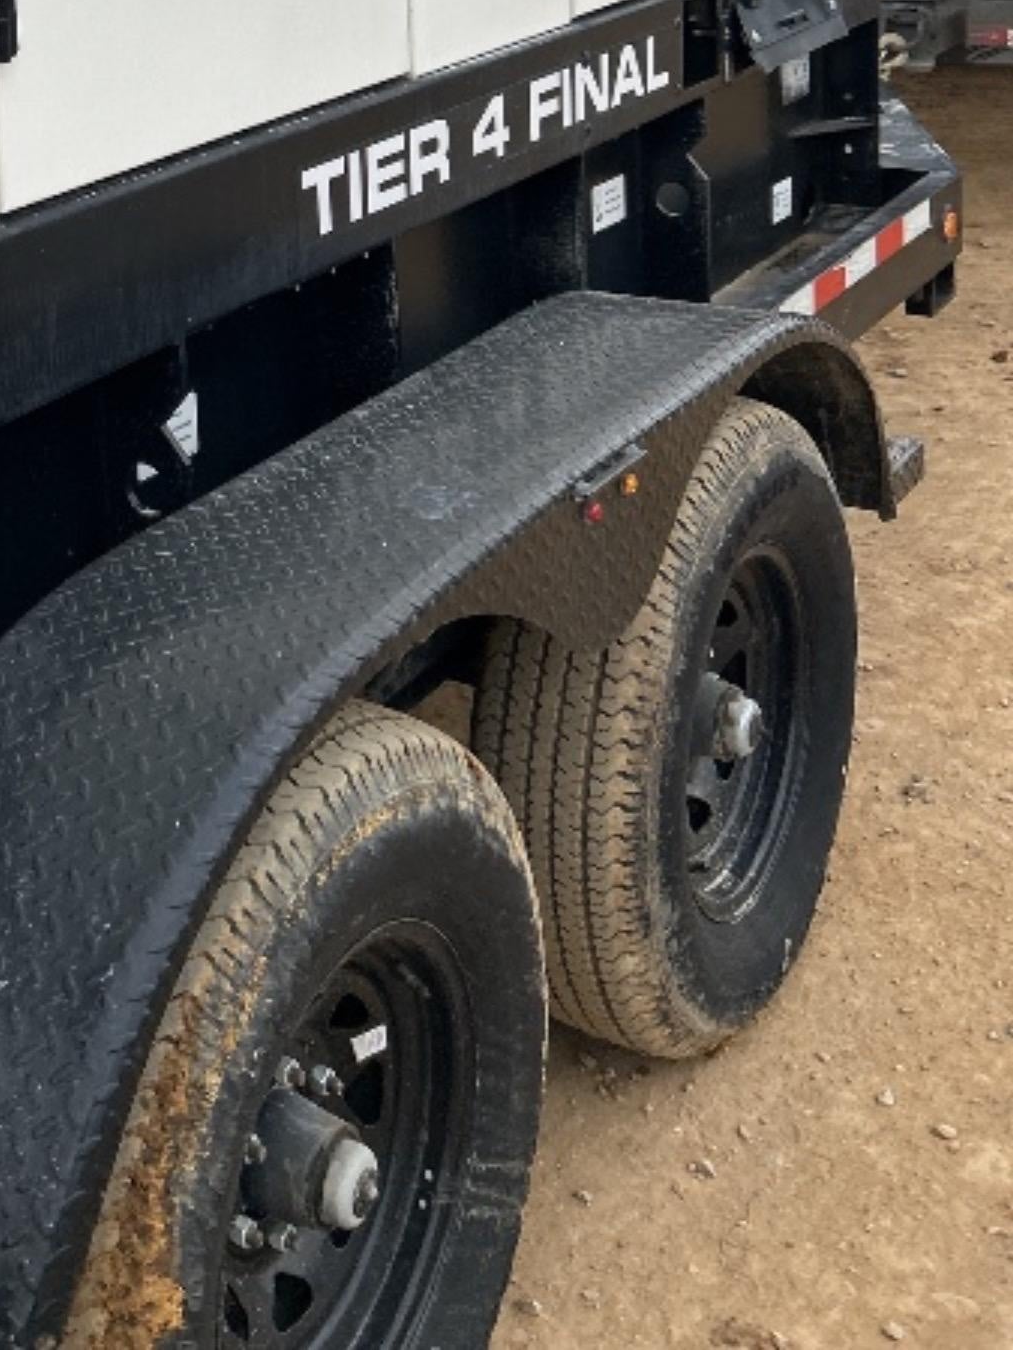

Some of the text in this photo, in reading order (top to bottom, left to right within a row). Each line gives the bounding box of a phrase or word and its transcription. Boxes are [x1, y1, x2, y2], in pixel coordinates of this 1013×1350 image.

[301, 119, 451, 236] TIER
[472, 93, 511, 158] 4
[529, 35, 670, 142] FINAL
